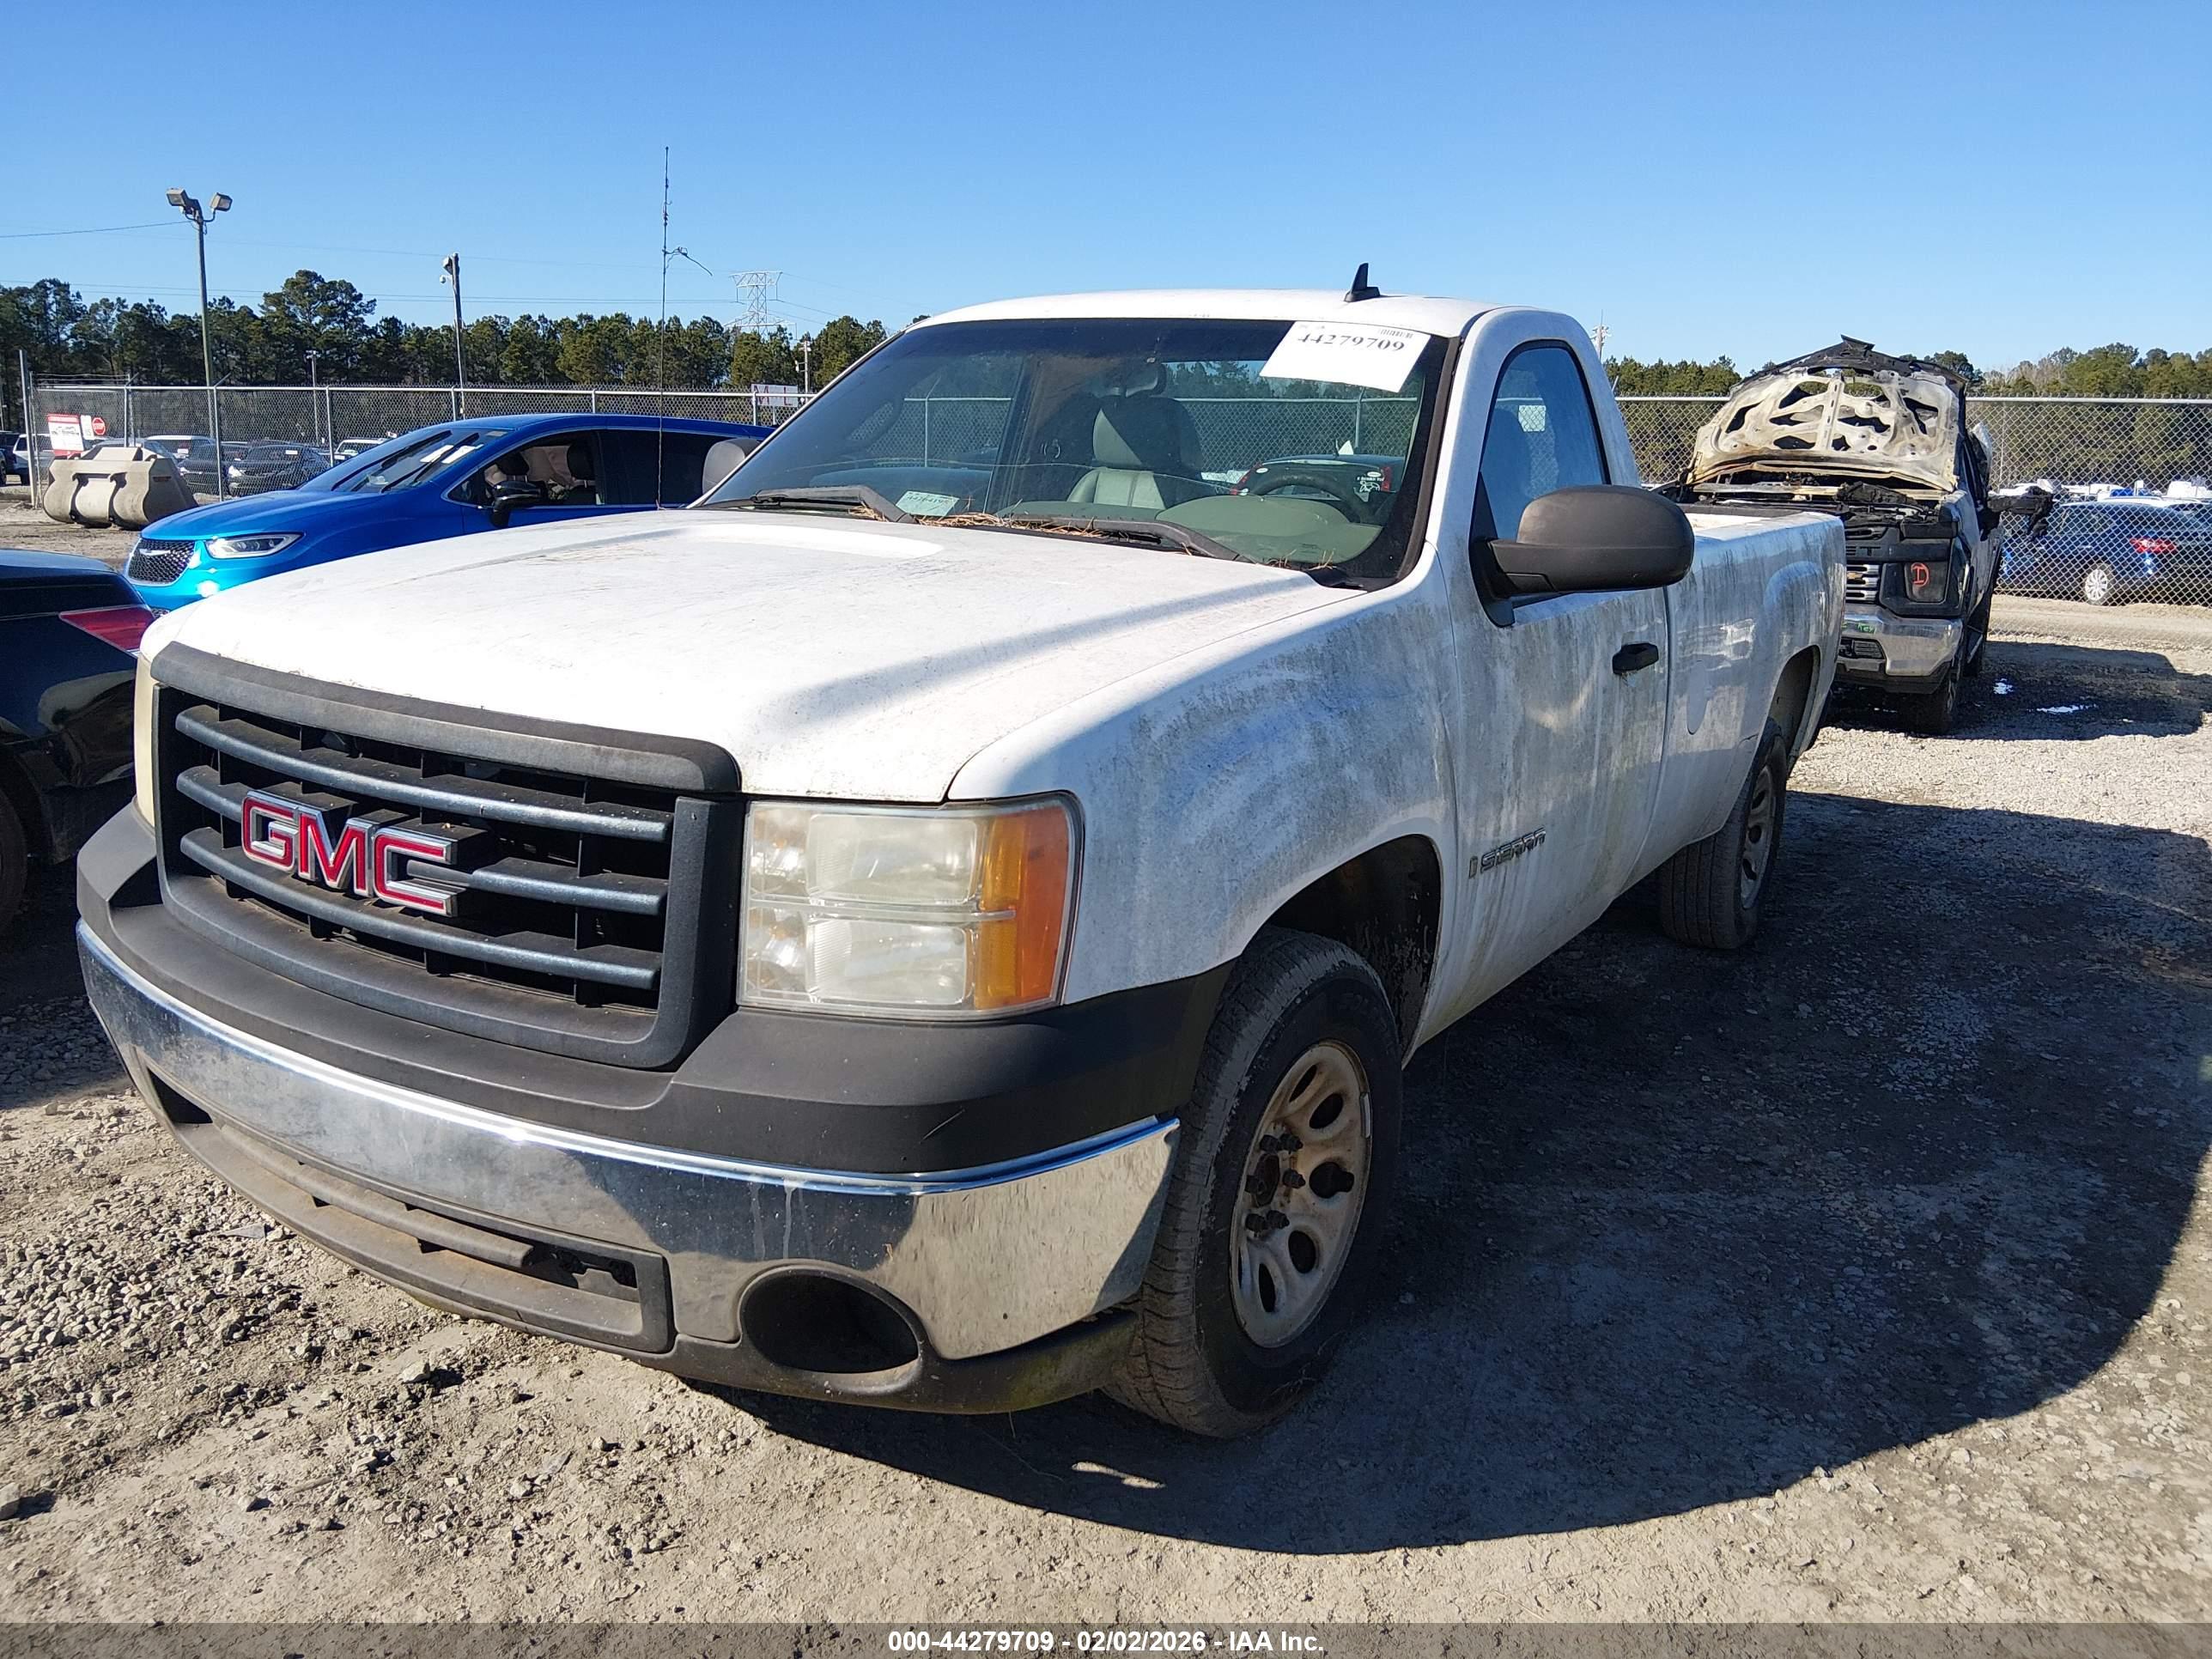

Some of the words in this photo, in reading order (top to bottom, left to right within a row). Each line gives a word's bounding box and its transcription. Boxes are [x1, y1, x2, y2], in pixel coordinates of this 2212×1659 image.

[1297, 333, 1405, 350] 44279709
[240, 789, 459, 918] GMC
[1480, 824, 1547, 874] SIERRA
